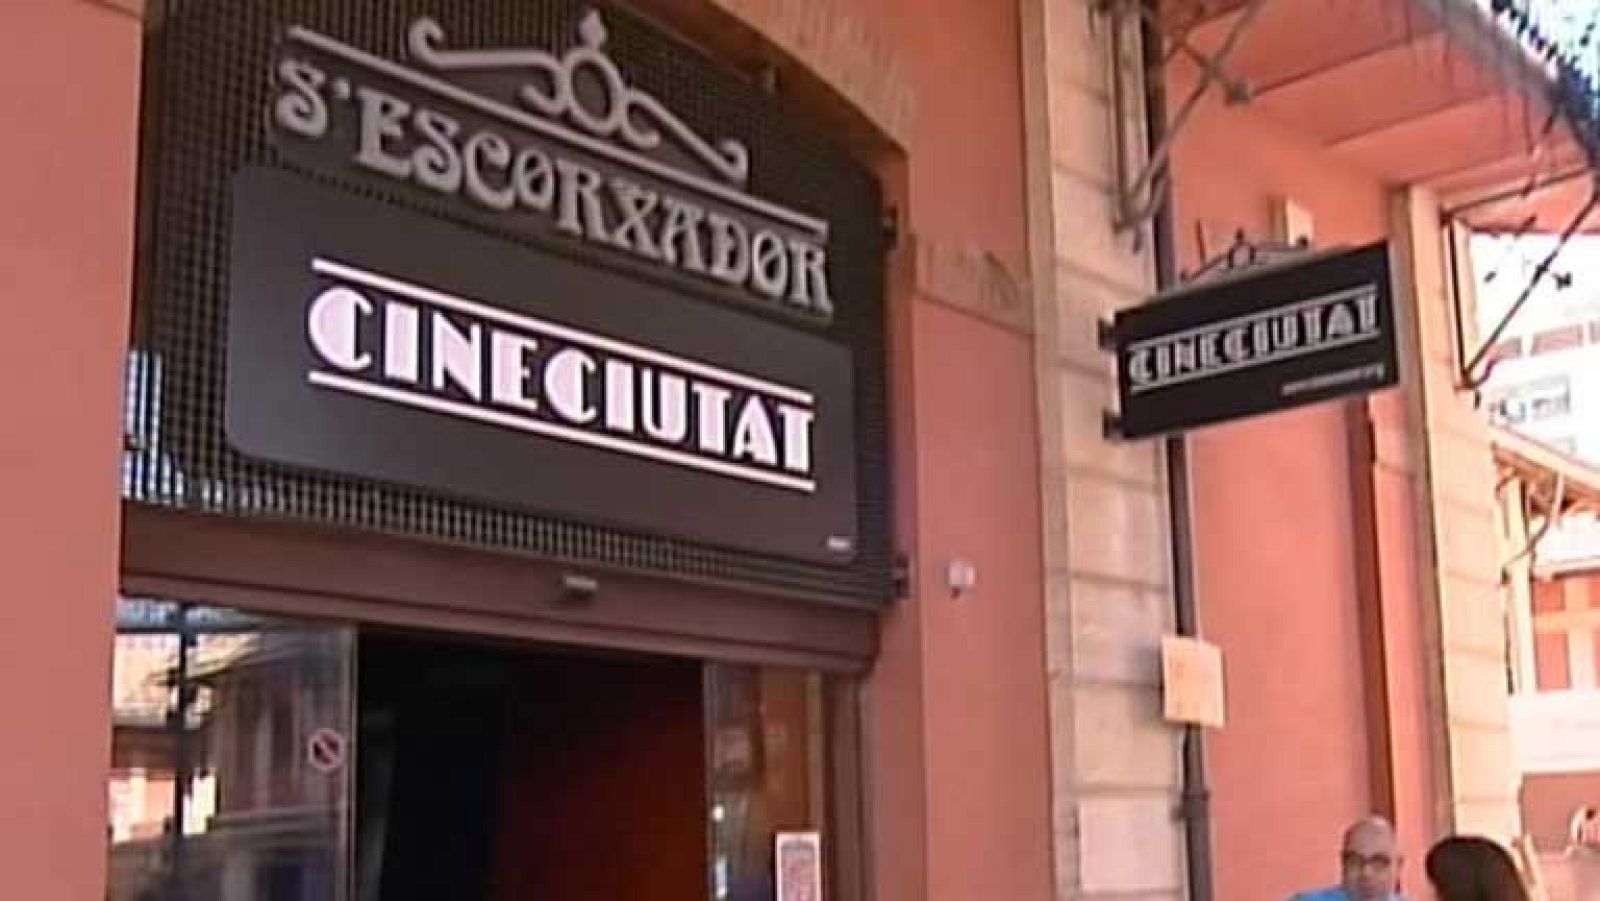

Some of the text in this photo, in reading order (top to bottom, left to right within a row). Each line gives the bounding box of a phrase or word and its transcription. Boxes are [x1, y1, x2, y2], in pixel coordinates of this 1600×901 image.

[275, 56, 833, 313] S'ESCORXADOR
[307, 285, 816, 473] CINECIUTAT
[1128, 294, 1379, 386] CINECIUTAT
